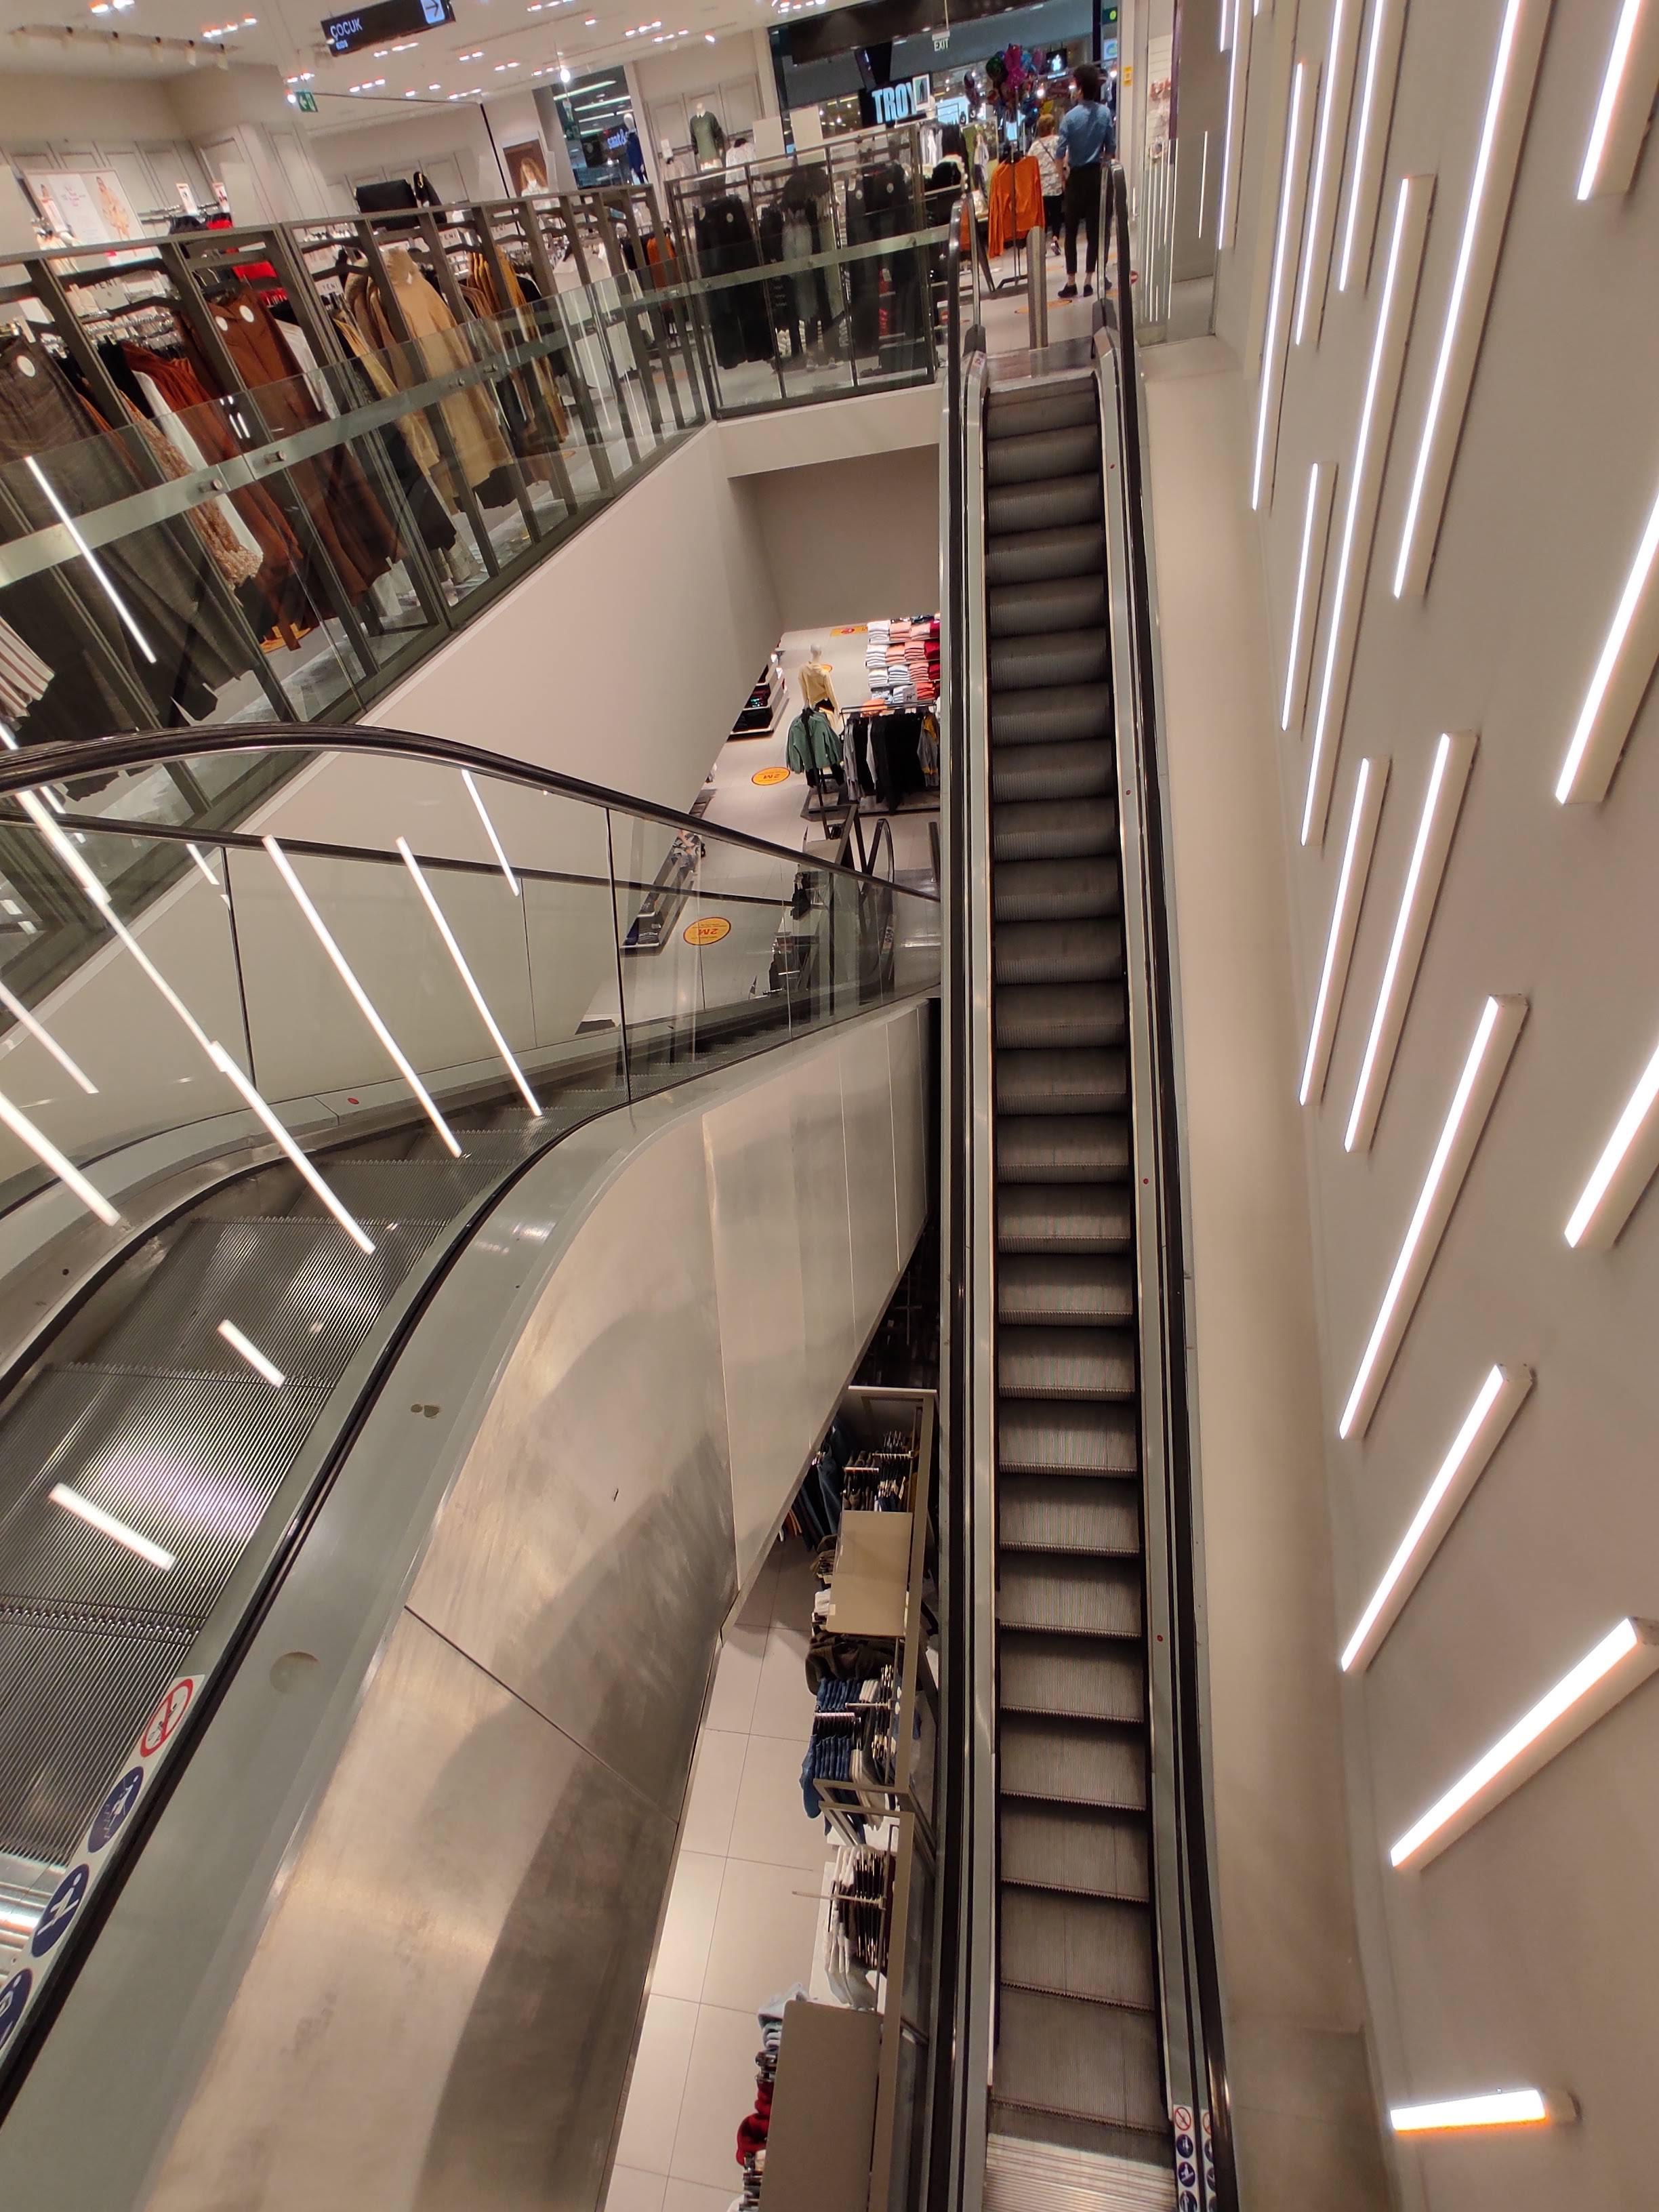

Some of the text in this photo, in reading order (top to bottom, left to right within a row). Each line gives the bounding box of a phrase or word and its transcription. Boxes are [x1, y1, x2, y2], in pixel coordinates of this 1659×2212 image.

[330, 18, 363, 40] ÇOCUK
[935, 38, 949, 52] EXIT
[872, 82, 917, 124] TROY
